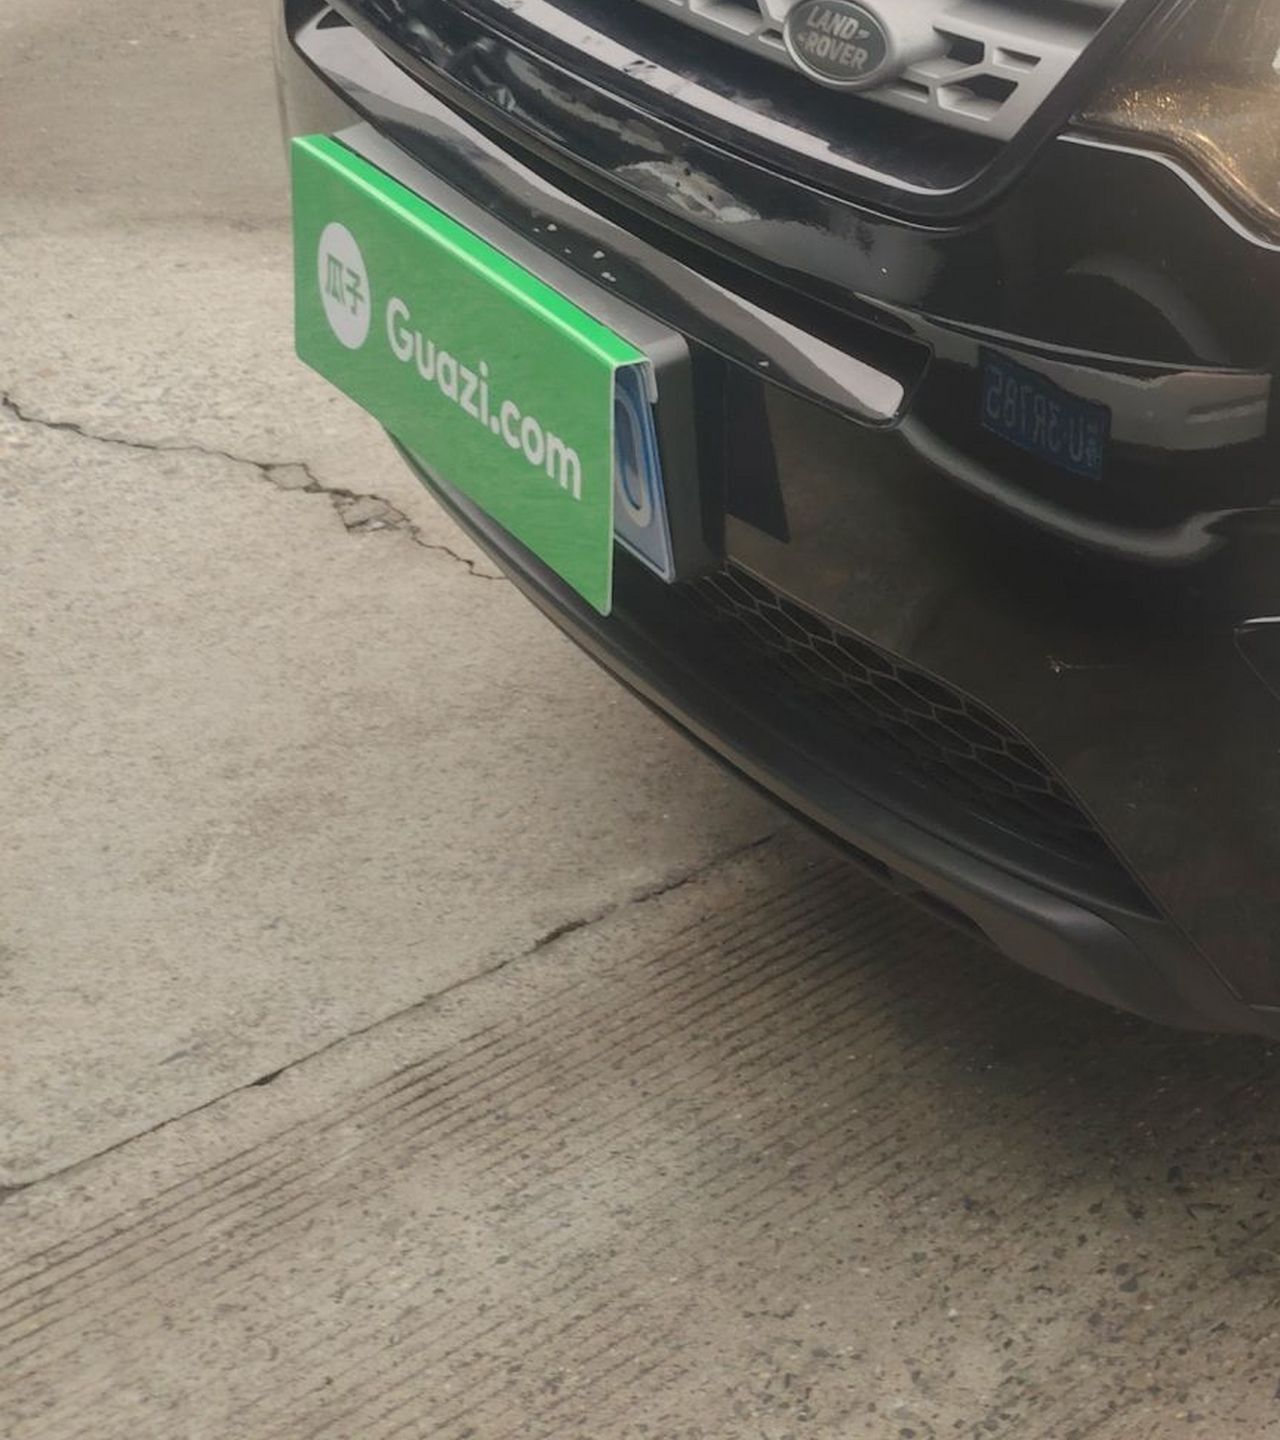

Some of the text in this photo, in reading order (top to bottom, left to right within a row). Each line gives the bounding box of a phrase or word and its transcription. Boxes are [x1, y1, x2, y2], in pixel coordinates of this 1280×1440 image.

[806, 6, 860, 40] LAND
[804, 31, 869, 70] ROVER
[325, 252, 366, 316] 瓜子
[386, 296, 583, 502] Guazi.com
